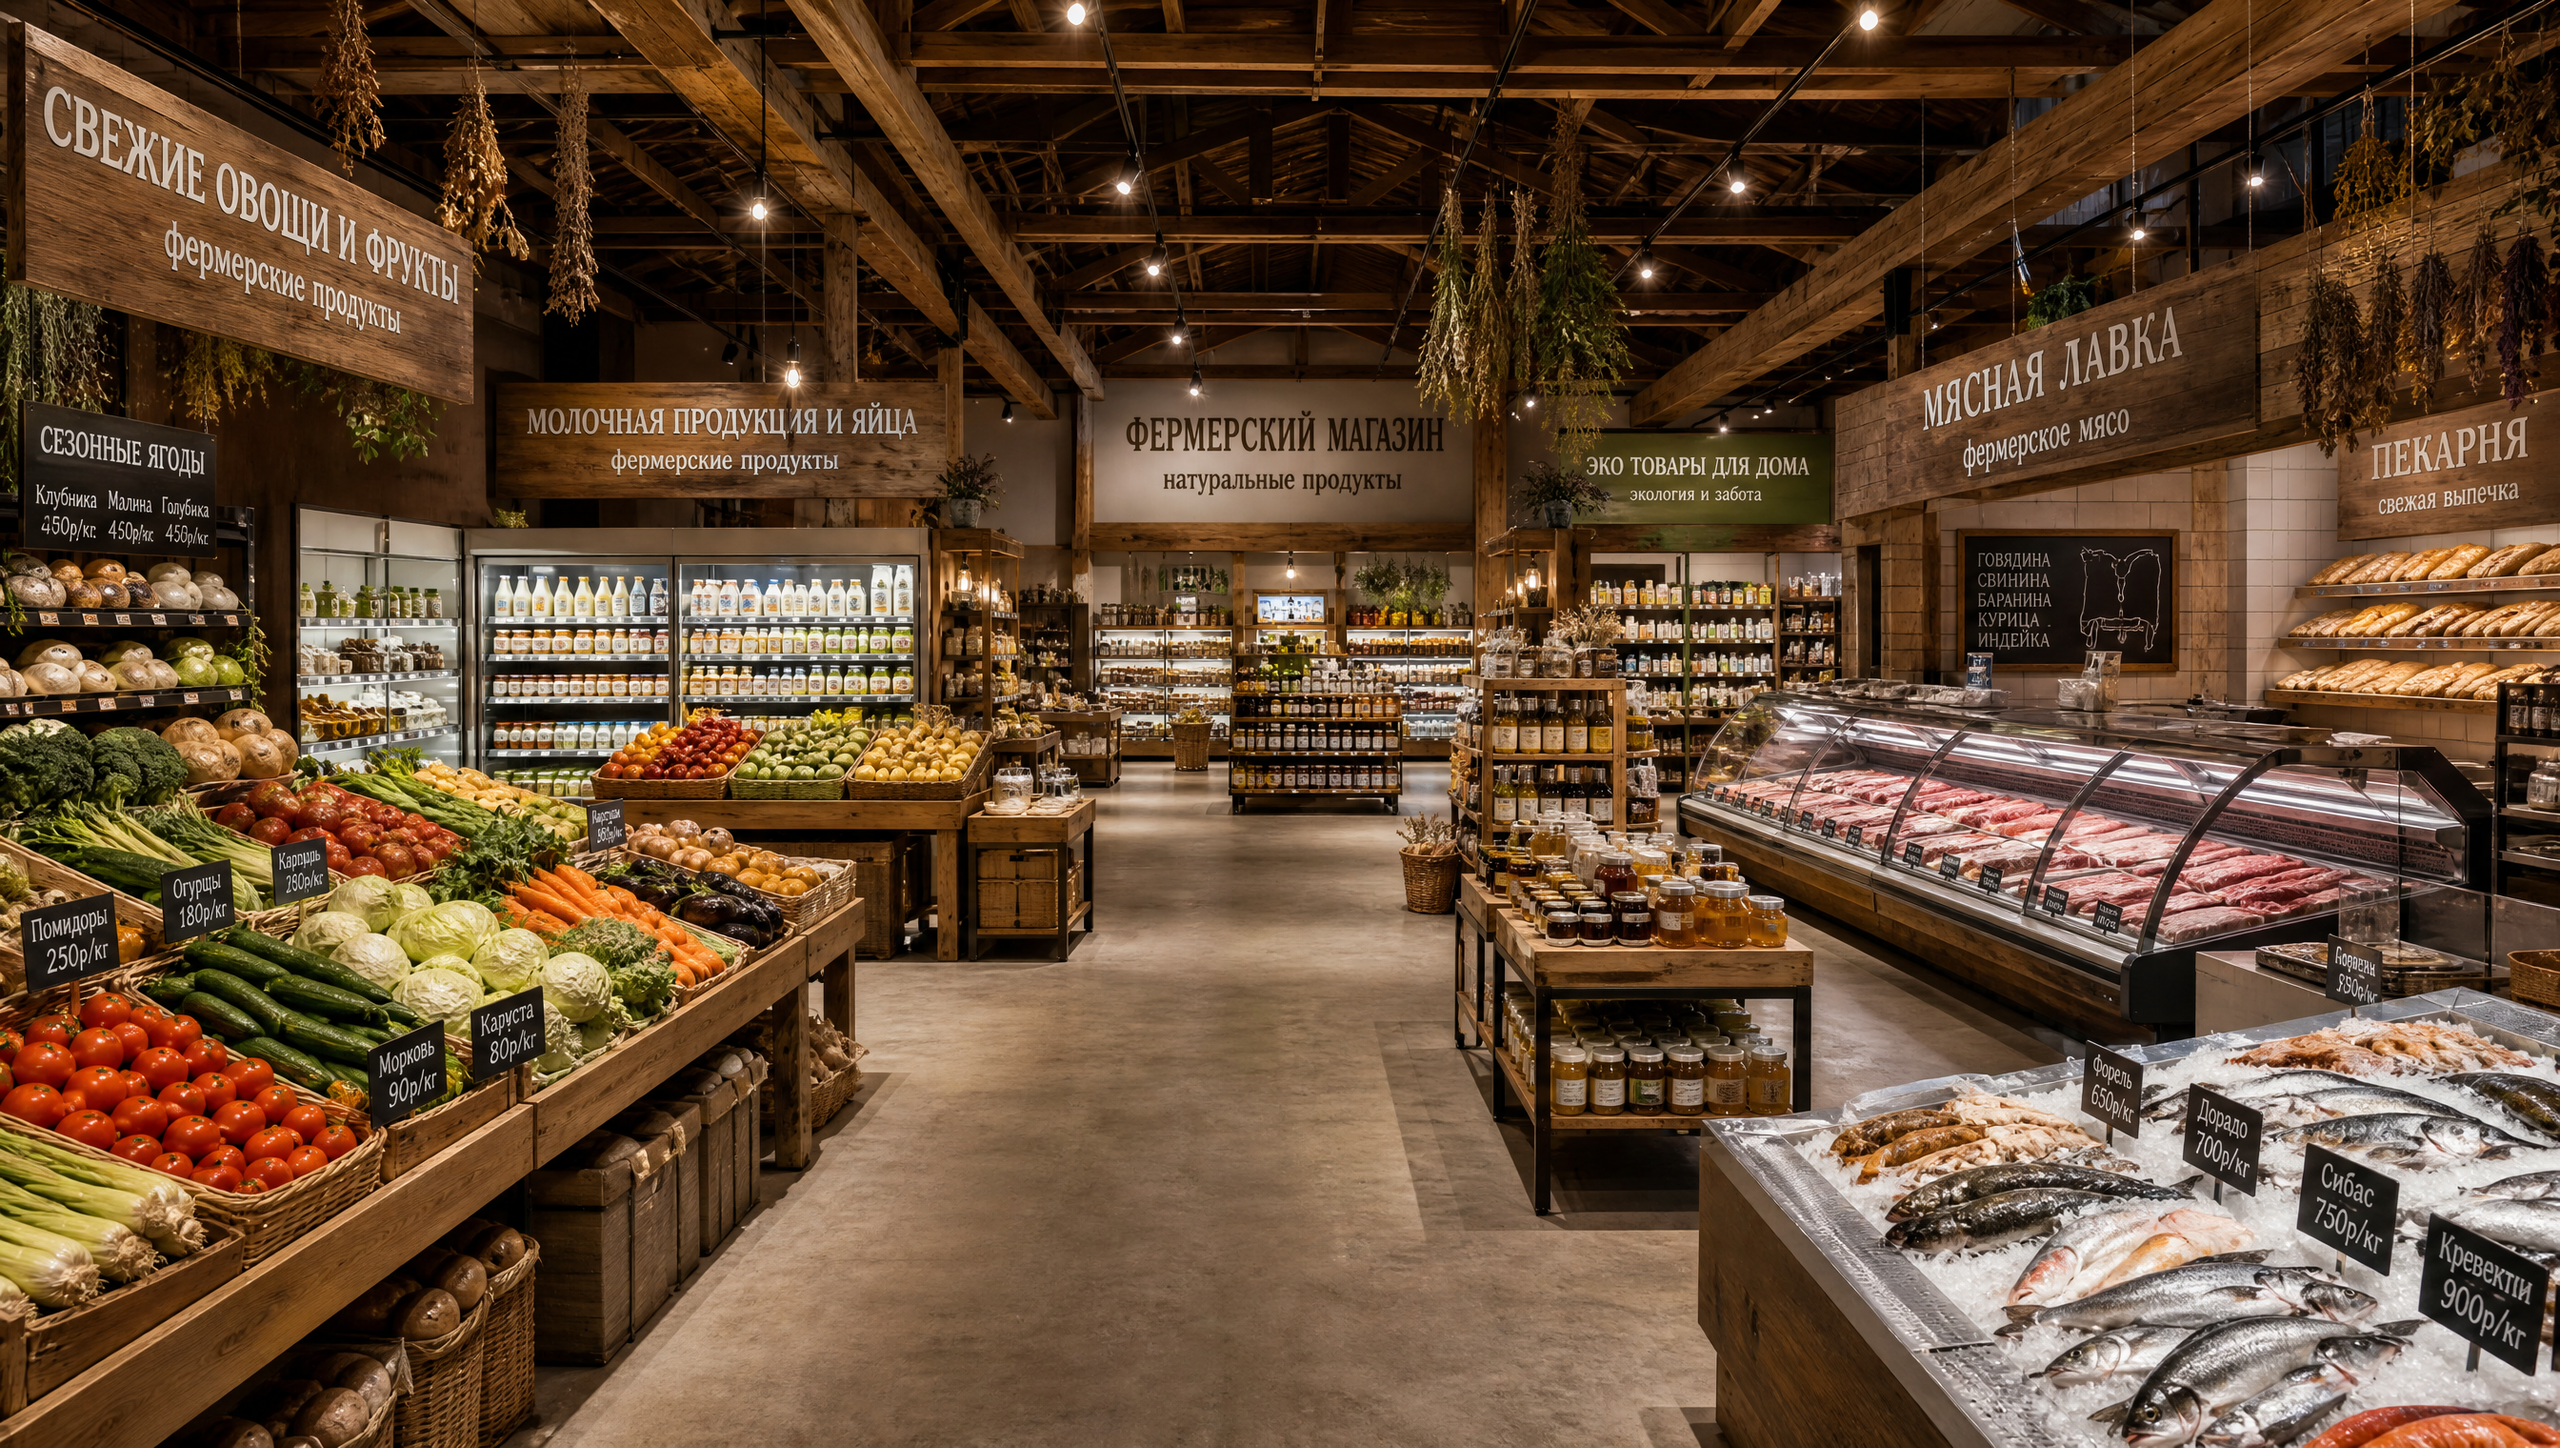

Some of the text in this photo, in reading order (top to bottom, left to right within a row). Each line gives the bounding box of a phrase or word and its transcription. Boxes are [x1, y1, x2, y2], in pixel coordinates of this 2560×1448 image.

[43, 86, 460, 305] СВЕЖИЕ ОВОЩИ И ФРУКТЫ
[164, 220, 401, 335] фермерские продукты
[1922, 307, 2183, 431] МЯСНАЯ ЛАВКА
[527, 402, 918, 440] МОЛОЧНАЯ ПРОДУКЦИЯ И ЯЙЦА
[1126, 410, 1444, 452] ФЕРМЕРСКИЙ МАГАЗИН
[40, 425, 205, 479] СЕЗОННЫЕ ЯГОДЫ
[1963, 408, 2130, 477] фермерское мясо
[2371, 416, 2529, 480] ПЕКАРНЯ
[610, 448, 839, 476] фермерские продукты
[1586, 456, 1810, 479] ЭКО ТОВАРЫ ДЛЯ ДОМА
[35, 484, 209, 520] Клубника Малина Голубика
[1163, 472, 1402, 496] натуральные продукты
[1630, 486, 1762, 502] экология и забота
[2379, 482, 2520, 515] свежая выпечка
[1977, 552, 2051, 570] ГОВЯДИНА
[1977, 573, 2051, 588] СВИНИНА
[1977, 592, 2052, 608] БАРАНИНА
[1977, 612, 2040, 629] КУРИЦА
[1977, 629, 2051, 650] ИНДЕЙКА
[30, 908, 108, 943] Помидоры
[179, 898, 228, 929] 180р/кг
[46, 938, 109, 976] 250р/кг
[379, 1040, 435, 1079] Морковь
[489, 1029, 537, 1065] 80р/кг
[388, 1069, 437, 1109] 90р/кг
[2092, 1054, 2133, 1090] Форель
[2091, 1084, 2135, 1124] 650р/кг
[2196, 1098, 2249, 1140] Дорадо
[2195, 1130, 2251, 1178] 700р/кг
[2321, 1163, 2375, 1208] Сибас
[2314, 1197, 2383, 1255] 750р/кг
[2440, 1278, 2527, 1351] 900р/кг
